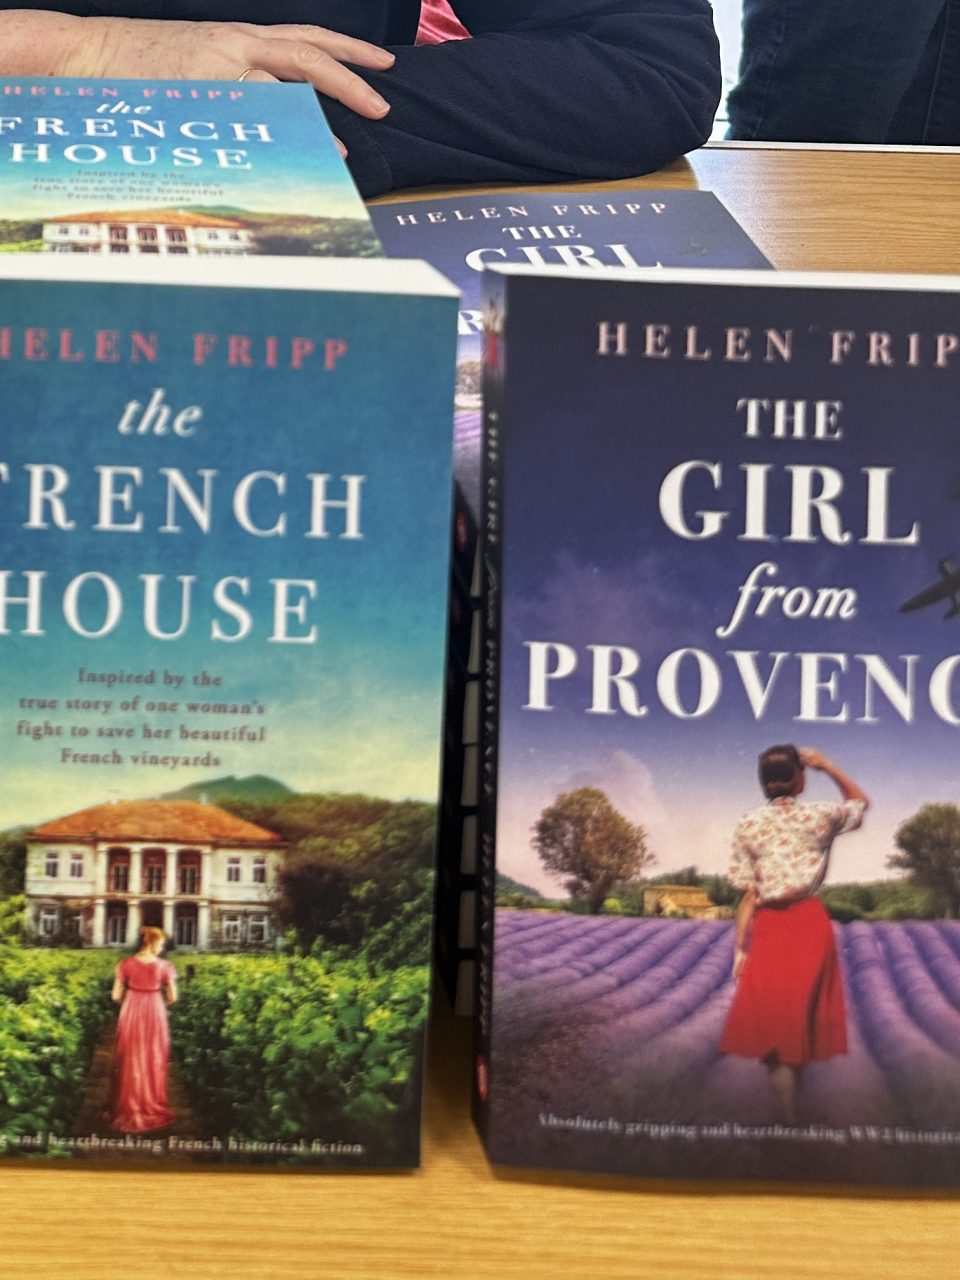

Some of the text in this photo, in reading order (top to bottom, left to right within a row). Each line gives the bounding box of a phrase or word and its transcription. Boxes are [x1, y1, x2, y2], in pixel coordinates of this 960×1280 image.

[96, 100, 152, 115] the
[9, 142, 253, 170] HOUSE
[396, 202, 667, 226] HELEN FRIPP
[502, 224, 583, 241] THE
[465, 243, 663, 273] GIRL
[192, 333, 349, 370] FRIPP
[597, 321, 960, 368] HELEN FRIP
[117, 387, 204, 438] the
[737, 398, 843, 440] THE
[658, 459, 921, 547] GIRL
[715, 560, 858, 640] from
[77, 667, 223, 690] Inspired by the
[19, 696, 265, 715] true story of one woman's
[16, 720, 266, 742] fight to save her beautiful
[59, 748, 221, 769] French vineyards
[14, 1130, 42, 1146] and
[48, 1132, 162, 1152] heartbreaking
[168, 1135, 221, 1151] French
[228, 1137, 304, 1153] historical
[311, 1139, 363, 1155] fiction
